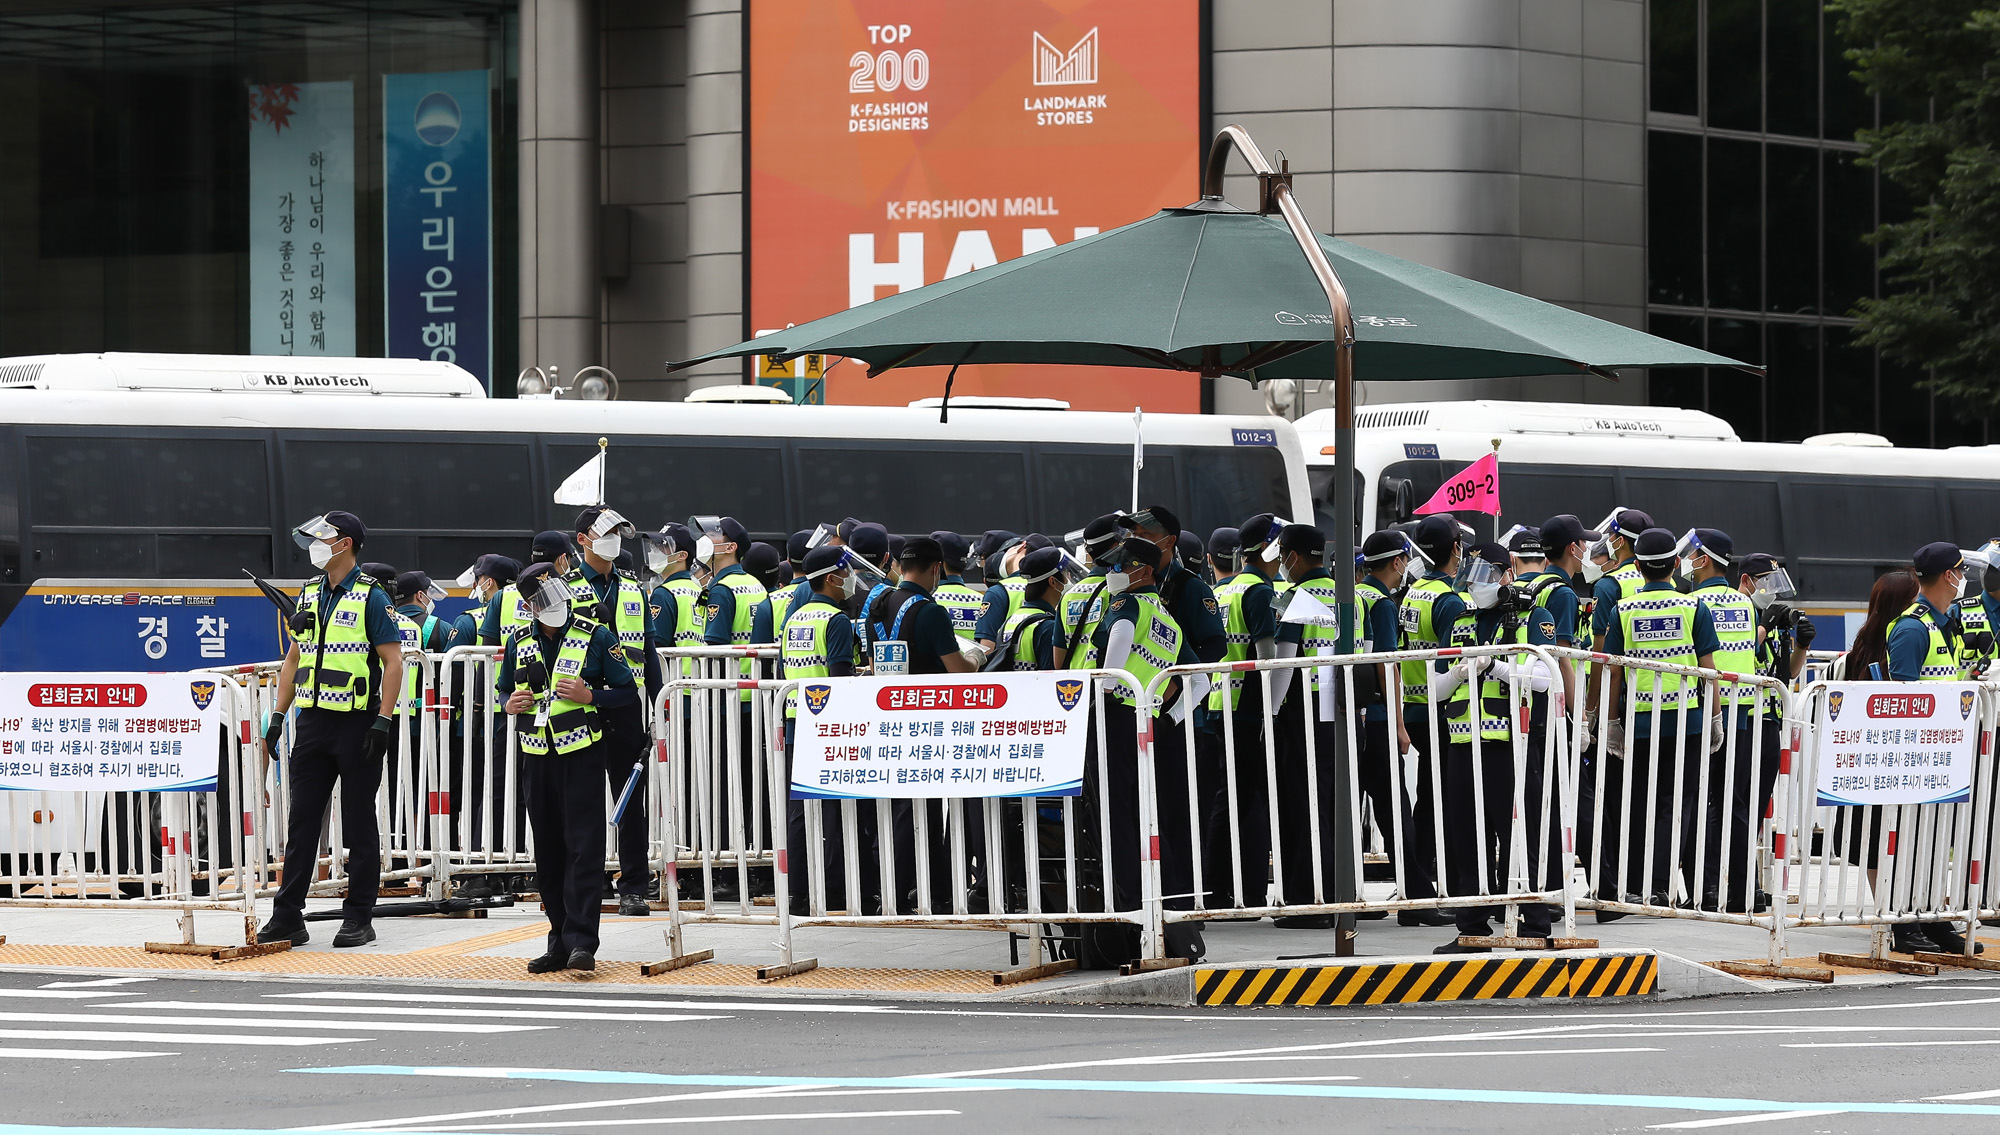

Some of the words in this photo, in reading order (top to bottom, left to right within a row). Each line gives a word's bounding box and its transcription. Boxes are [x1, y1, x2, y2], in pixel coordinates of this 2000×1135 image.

[867, 24, 912, 44] TOP
[849, 48, 930, 93] 200
[850, 101, 929, 117] K-FASHION
[1023, 95, 1108, 111] LANDMARK
[848, 116, 929, 132] DESIGNERS
[1036, 111, 1094, 126] STORES
[308, 150, 325, 235] 하나님이
[278, 192, 295, 234] 가장
[886, 197, 998, 220] K-FASHION
[1003, 196, 1060, 217] MALL
[278, 240, 295, 282] 좋은
[420, 161, 458, 363] 우리은행
[309, 241, 326, 304] 우리와
[279, 288, 295, 357] 것입니
[309, 310, 326, 351] 함께
[263, 374, 288, 386] KB
[294, 375, 369, 387] AutoTech
[1595, 420, 1612, 430] KB
[1613, 421, 1663, 432] AutoTech
[1235, 432, 1273, 443] 1012-3
[1407, 446, 1437, 457] 1012-2
[1446, 474, 1495, 506] 309-2
[953, 620, 977, 628] POLI
[1715, 622, 1747, 630] POLICE
[1151, 632, 1173, 651] POLICE
[1638, 631, 1678, 639] POLICE
[556, 667, 576, 675] POLICE
[875, 664, 903, 672] POLICE
[39, 686, 99, 705] 집회금지
[106, 686, 136, 705] 안내
[888, 689, 954, 708] 집회금지
[962, 688, 995, 707] 안내
[1872, 697, 1909, 716] 집회금지
[1912, 697, 1930, 715] 안내
[31, 717, 54, 733] 확산
[59, 717, 92, 733] 방지를
[97, 717, 120, 733] 위해
[124, 717, 202, 733] 감염병예방법과
[878, 722, 903, 737] 확산
[908, 721, 945, 737] 방지를
[951, 721, 975, 737] 위해
[981, 720, 1067, 736] 감염병예방법과
[1866, 729, 1880, 744] 확산
[1882, 729, 1901, 744] 방지를
[1903, 729, 1917, 744] 위해
[1919, 728, 1964, 744] 감염병예방법과
[31, 740, 54, 755] 따라
[149, 740, 183, 755] 집회를
[824, 746, 872, 761] 집시법에
[878, 745, 903, 761] 따라
[1008, 743, 1045, 759] 집회를
[1835, 753, 1862, 769] 집시법에
[1864, 753, 1879, 767] 따라
[1933, 751, 1952, 767] 집회를
[49, 763, 94, 778] 협조하여
[98, 763, 132, 778] 주시기
[136, 763, 184, 778] 바랍니다.
[819, 768, 890, 785] 금지하였으니
[896, 768, 945, 784] 협조하여
[950, 767, 988, 783] 주시기
[992, 766, 1045, 783] 바랍니다.
[1832, 776, 1871, 791] 금지하였으니
[1873, 775, 1900, 790] 협조하여
[1901, 774, 1922, 790] 주시기
[1923, 774, 1951, 789] 바랍니다.
